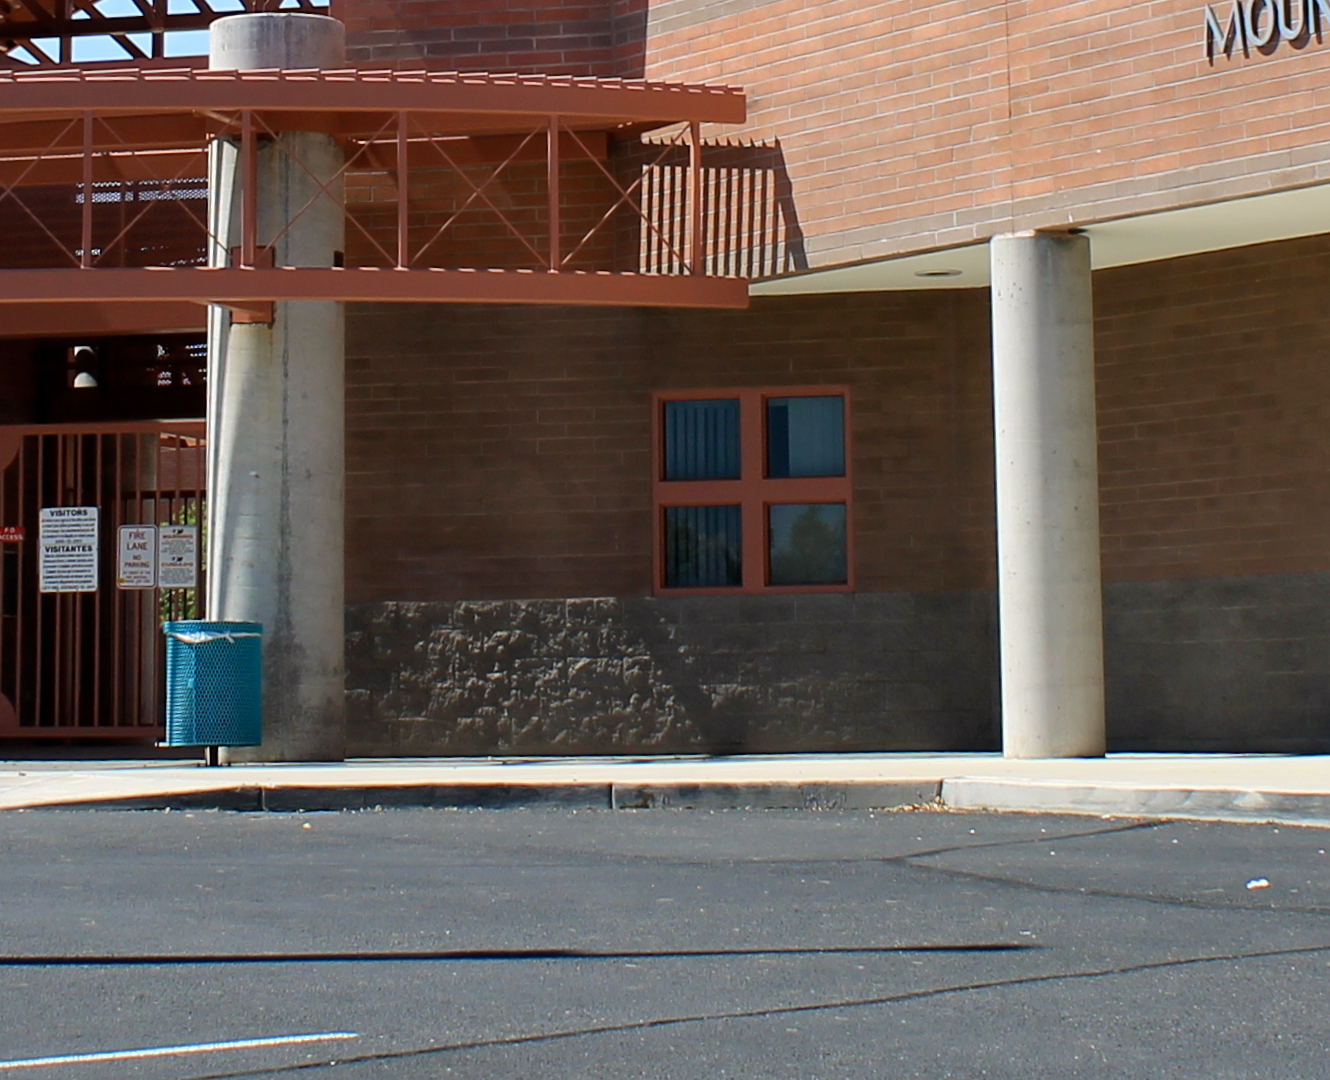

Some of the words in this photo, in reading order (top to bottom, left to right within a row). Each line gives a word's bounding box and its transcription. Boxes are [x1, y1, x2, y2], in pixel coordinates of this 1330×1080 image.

[49, 509, 88, 517] VISITORS
[128, 531, 146, 540] FIRE
[45, 545, 93, 553] VISITANTES
[126, 542, 148, 551] LANE
[124, 561, 151, 569] PARKING
